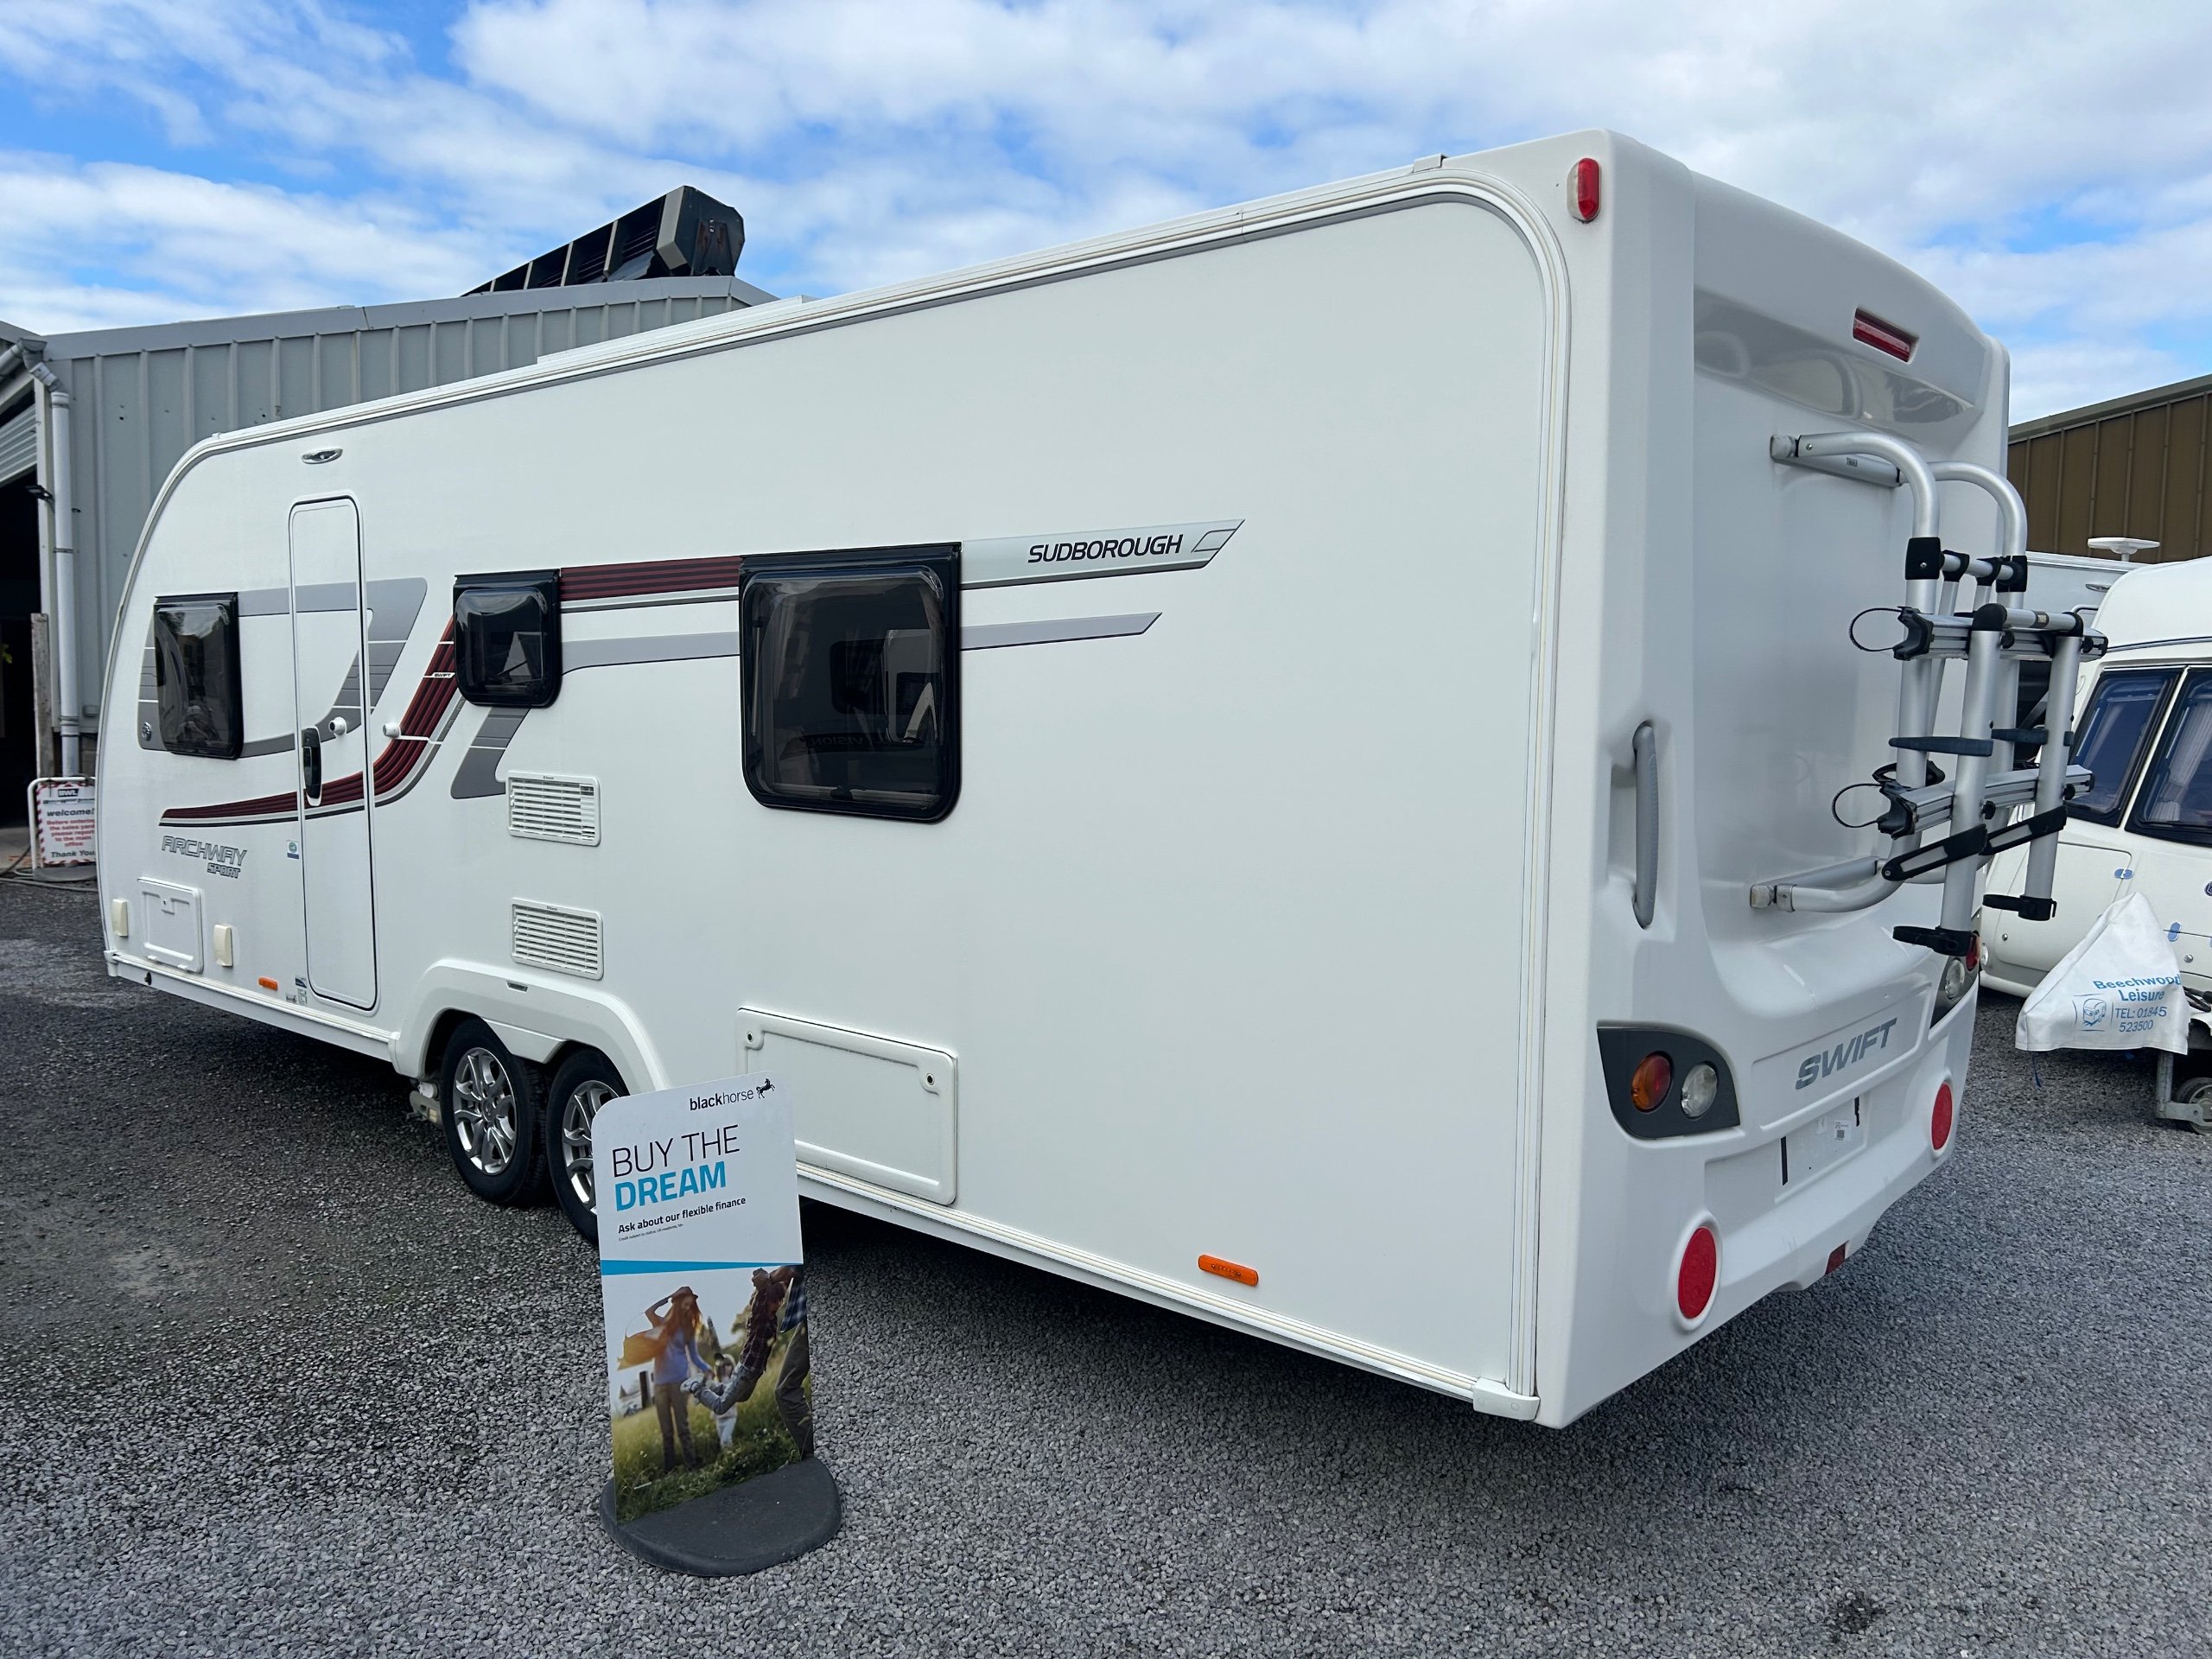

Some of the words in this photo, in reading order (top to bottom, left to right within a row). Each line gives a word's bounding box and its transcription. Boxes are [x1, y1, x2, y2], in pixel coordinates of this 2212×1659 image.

[1028, 534, 1184, 563] SUDBOROUGH
[162, 835, 247, 866] ARCHWAY
[207, 862, 241, 879] SPORT
[2118, 988, 2165, 1001] Leisure
[2115, 1007, 2134, 1019] TEL:
[2137, 1006, 2168, 1019] 01845
[2119, 1020, 2154, 1033] 523500
[1796, 1017, 1897, 1090] SWIFT
[690, 1090, 754, 1111] blackhorse
[612, 1138, 674, 1178] BUY
[681, 1124, 741, 1162] THE
[614, 1160, 727, 1212] DREAM
[618, 1222, 636, 1234] Ask
[637, 1216, 664, 1230] about
[665, 1212, 680, 1223] our
[682, 1205, 714, 1219] flexible
[715, 1197, 747, 1211] finance
